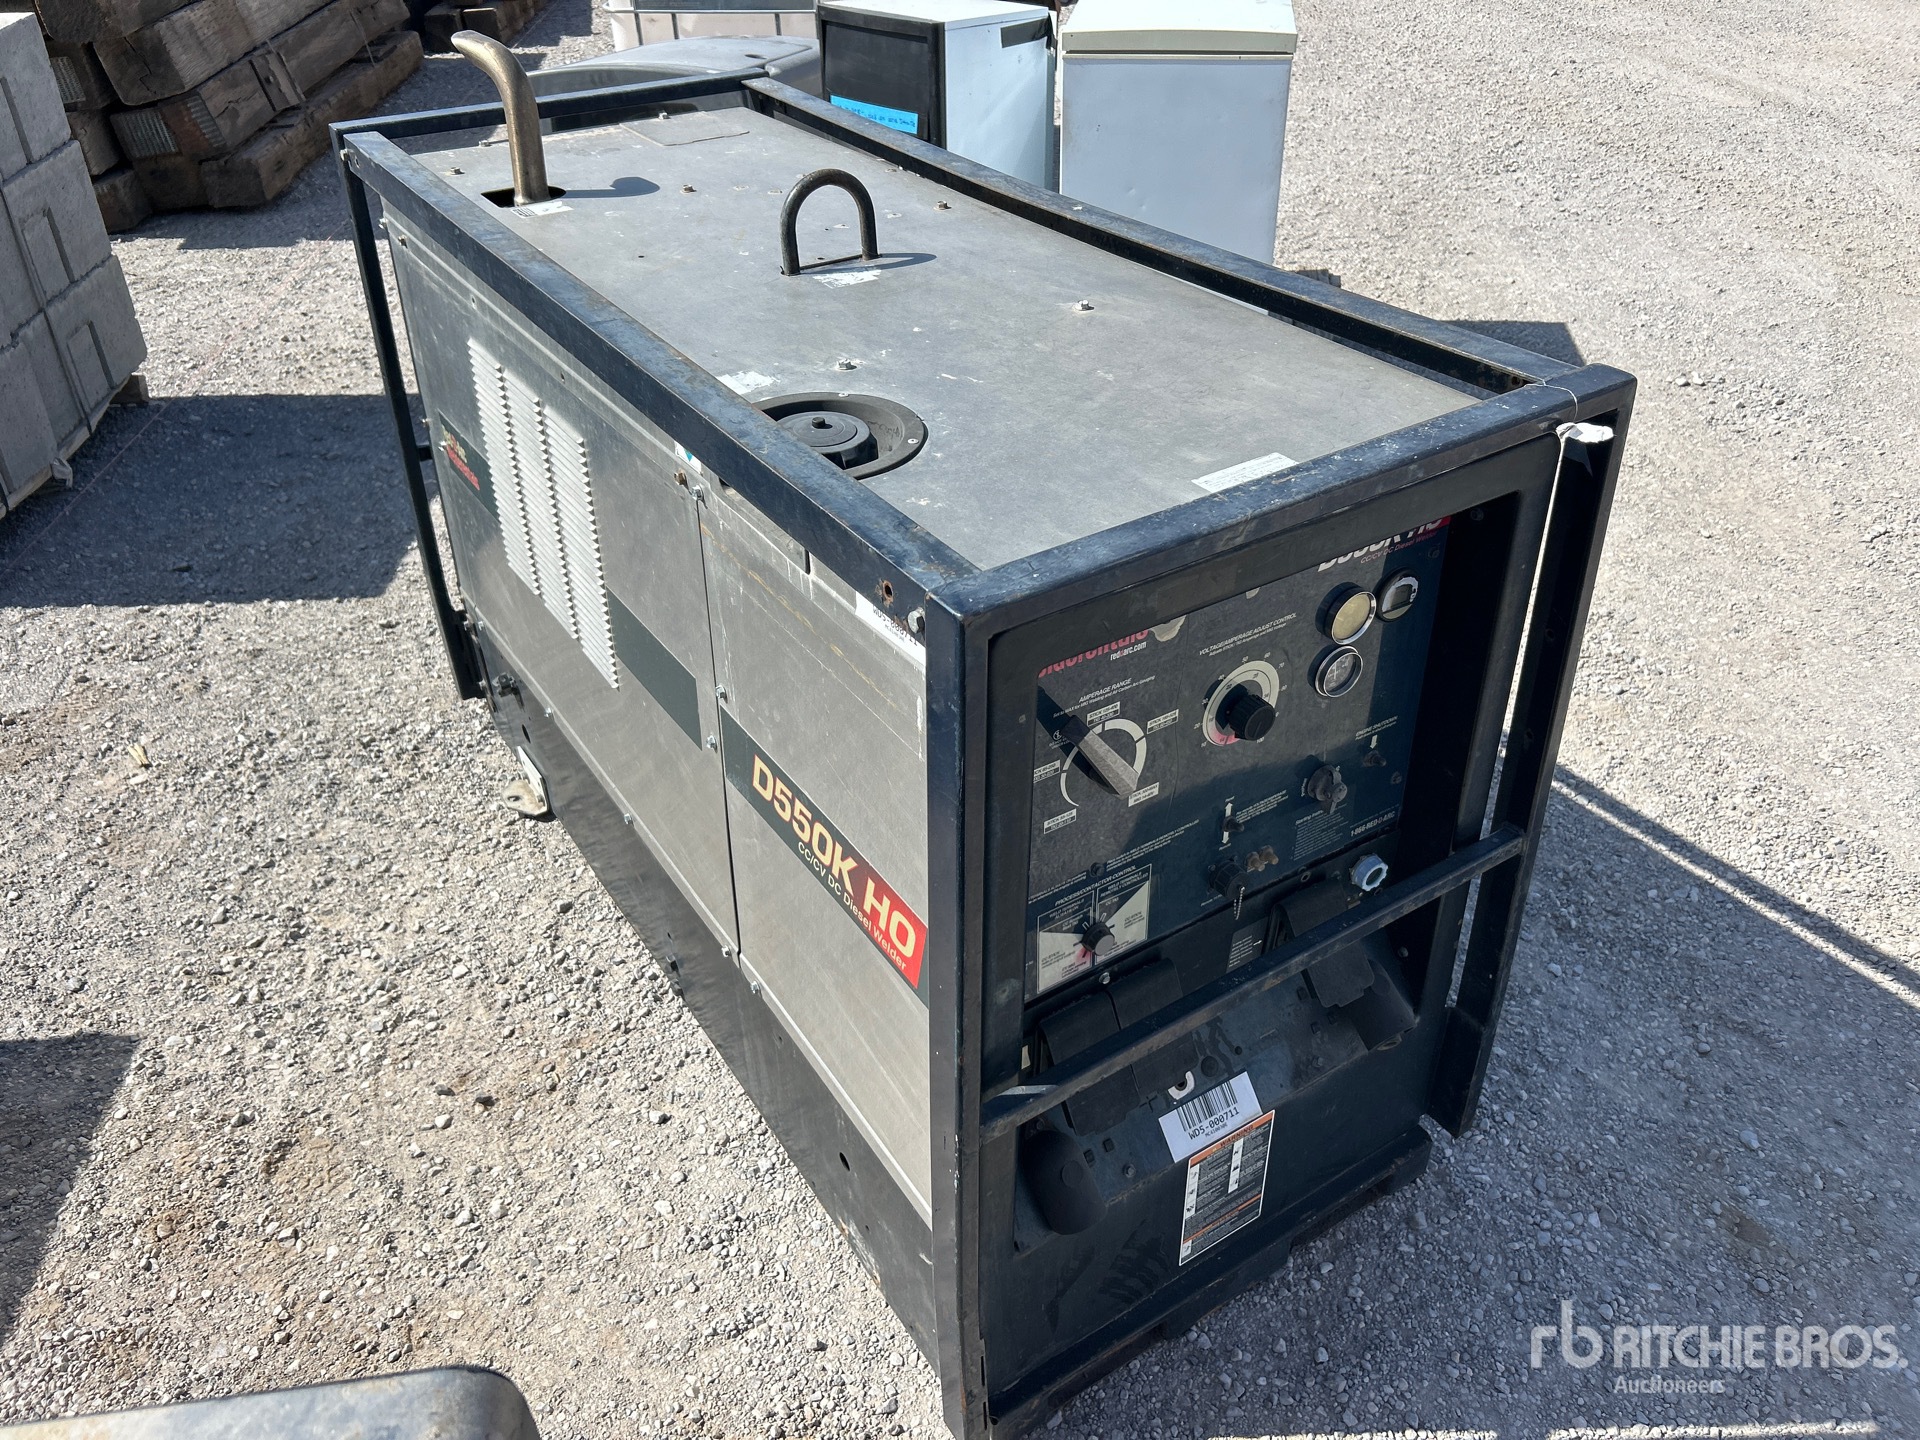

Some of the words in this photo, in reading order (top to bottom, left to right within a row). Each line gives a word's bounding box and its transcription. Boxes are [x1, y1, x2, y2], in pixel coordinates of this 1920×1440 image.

[1382, 545, 1395, 556] DC
[1078, 685, 1111, 703] AMPERAGE
[1111, 677, 1132, 691] RANGE
[752, 753, 860, 897] D550K
[863, 876, 917, 959] HO
[1054, 875, 1112, 906] PROCESS/CONTACTOR
[1112, 864, 1137, 880] CONTROL
[797, 841, 827, 878] CC/CV
[827, 873, 842, 896] DC
[843, 892, 872, 931] Diesel
[873, 923, 907, 971] Welder
[1187, 1106, 1240, 1140] WD5-000711
[1219, 1124, 1255, 1147] WARNING
